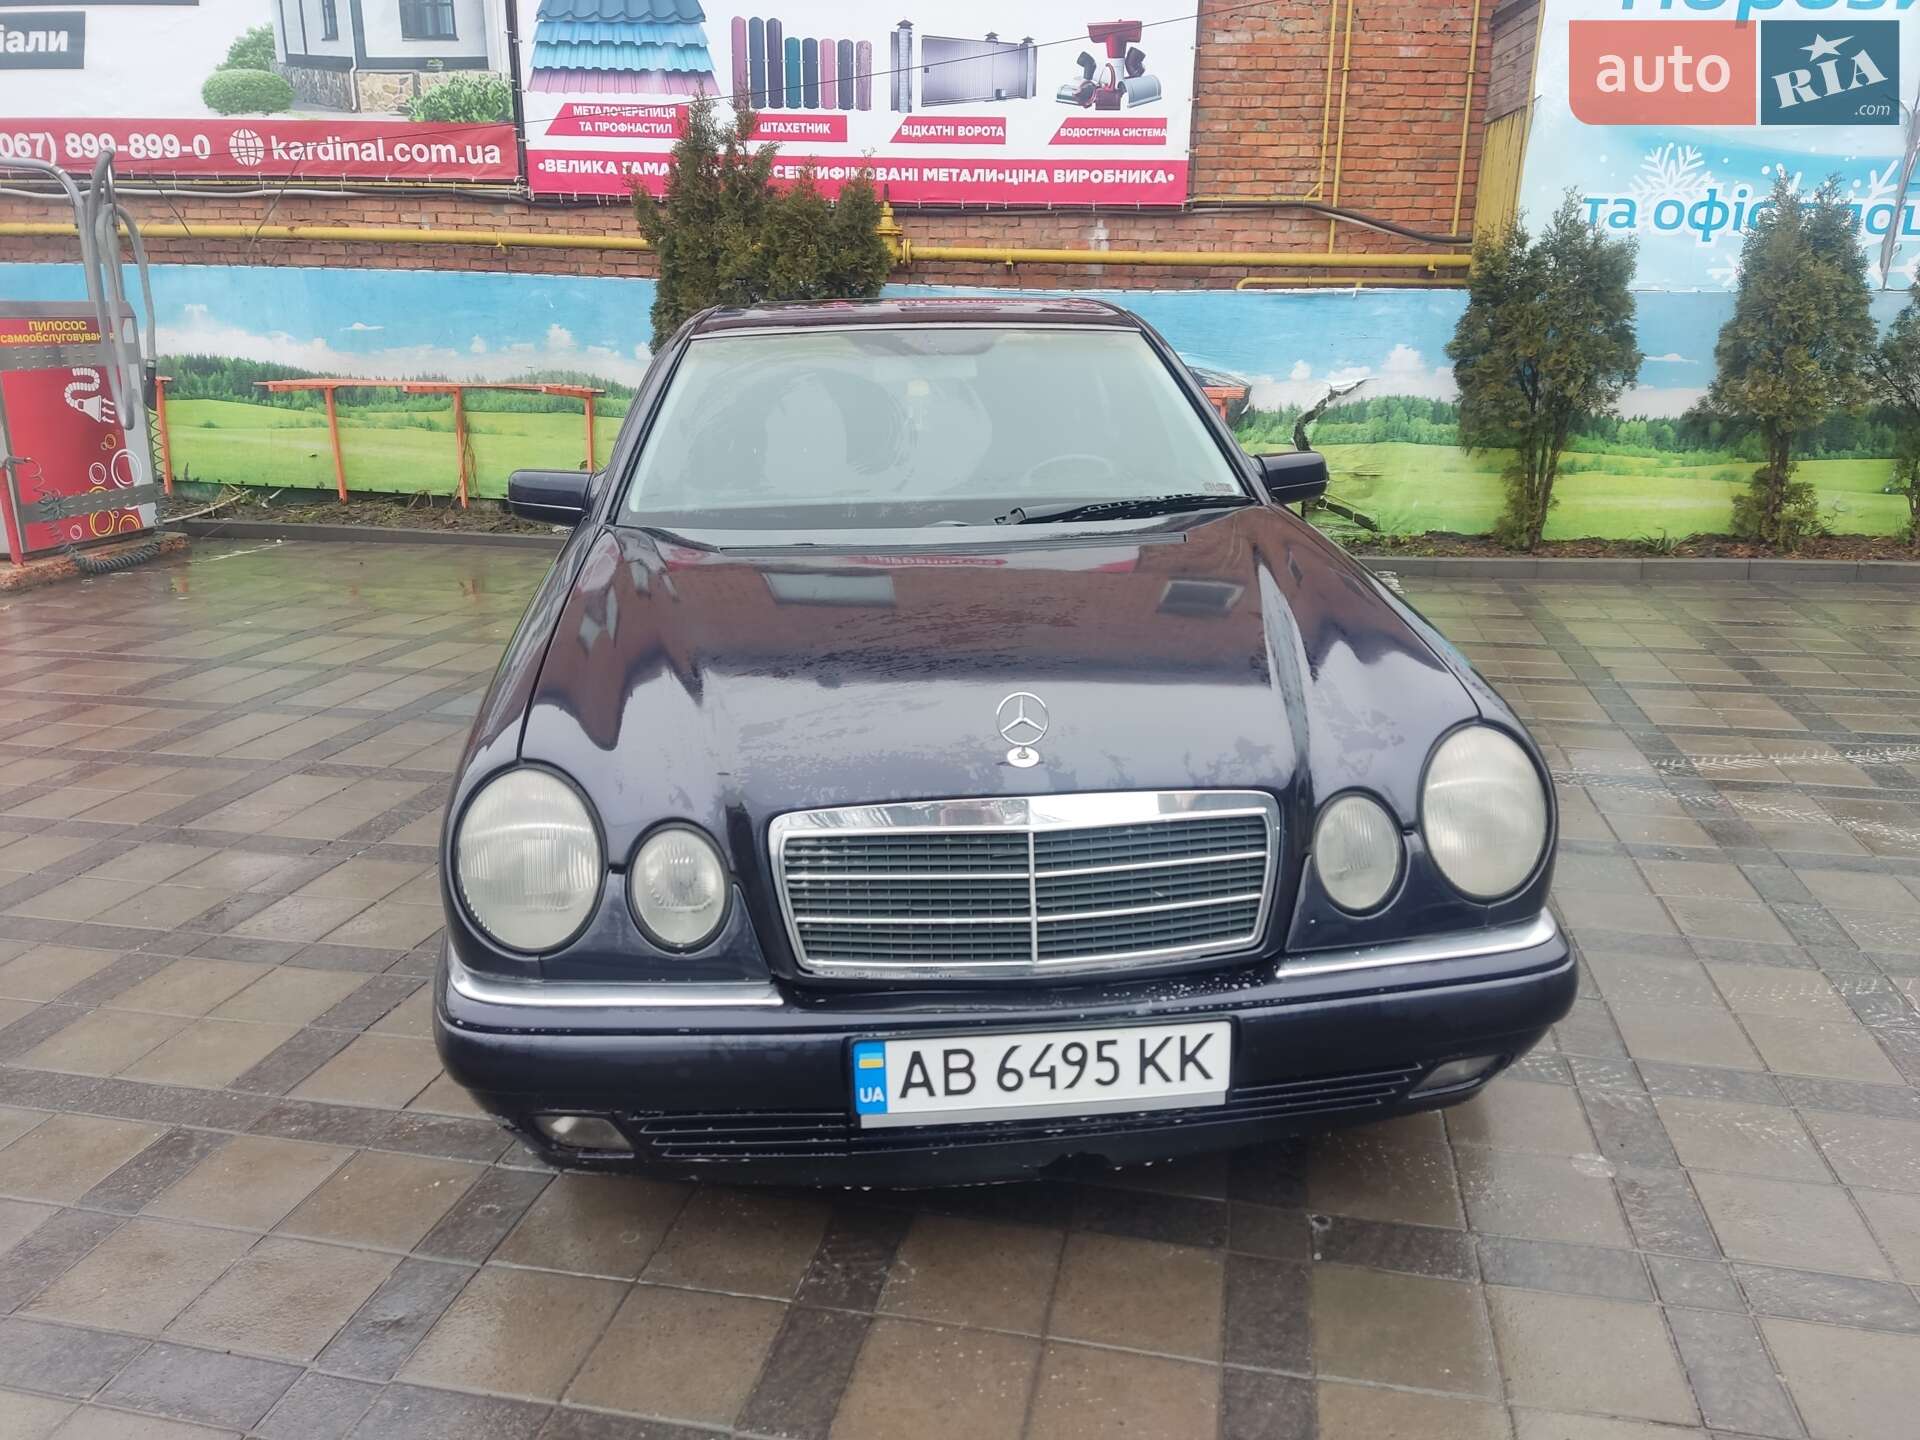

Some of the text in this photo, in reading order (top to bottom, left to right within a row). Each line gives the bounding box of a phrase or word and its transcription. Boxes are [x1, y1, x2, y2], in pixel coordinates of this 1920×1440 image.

[573, 105, 677, 119] МЕТАЛОЧЕРЕПИЦЯ
[579, 121, 672, 134] ТА ПРОФНАСТИЛ
[760, 122, 831, 135] ШТАХЕТНИК
[901, 125, 1005, 137] ВІДКАТНІ ВОРОТА
[1060, 128, 1168, 138] ВОДОСТІЧНА СИСТЕМА
[65, 132, 211, 160] 899-899-0
[271, 136, 501, 165] kardinal.com.ua
[1583, 197, 1638, 230] та
[900, 1033, 1214, 1099] AB 6495 KK
[860, 1088, 884, 1104] UA
